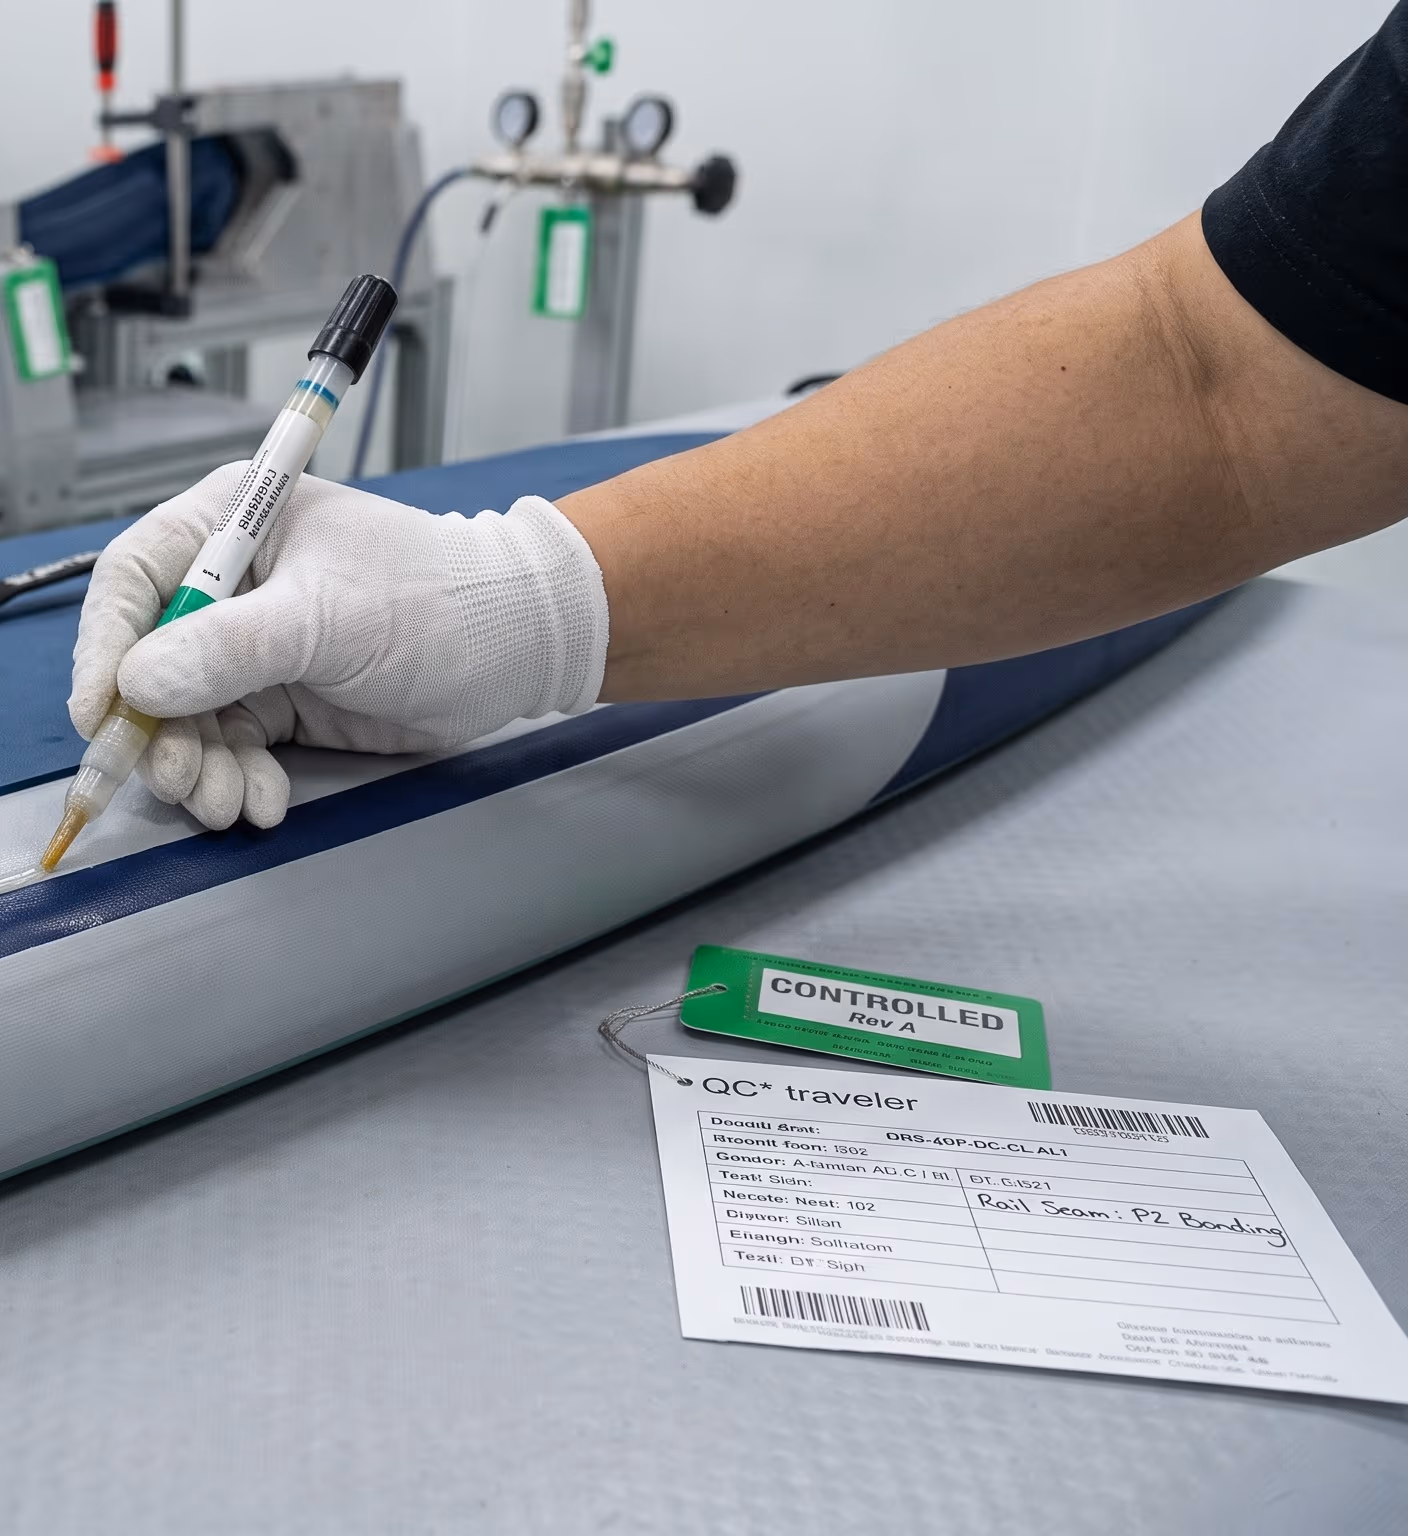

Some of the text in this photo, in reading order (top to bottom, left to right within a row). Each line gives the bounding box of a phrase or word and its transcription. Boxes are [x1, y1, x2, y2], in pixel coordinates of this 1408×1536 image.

[770, 977, 1004, 1031] CONTROLLED
[848, 1011, 917, 1034] Rev A
[785, 1084, 919, 1111] traveler
[847, 1200, 877, 1212] 102
[977, 1193, 1032, 1213] Rail
[1131, 1208, 1170, 1225] P2
[1178, 1212, 1288, 1248] Bonding
